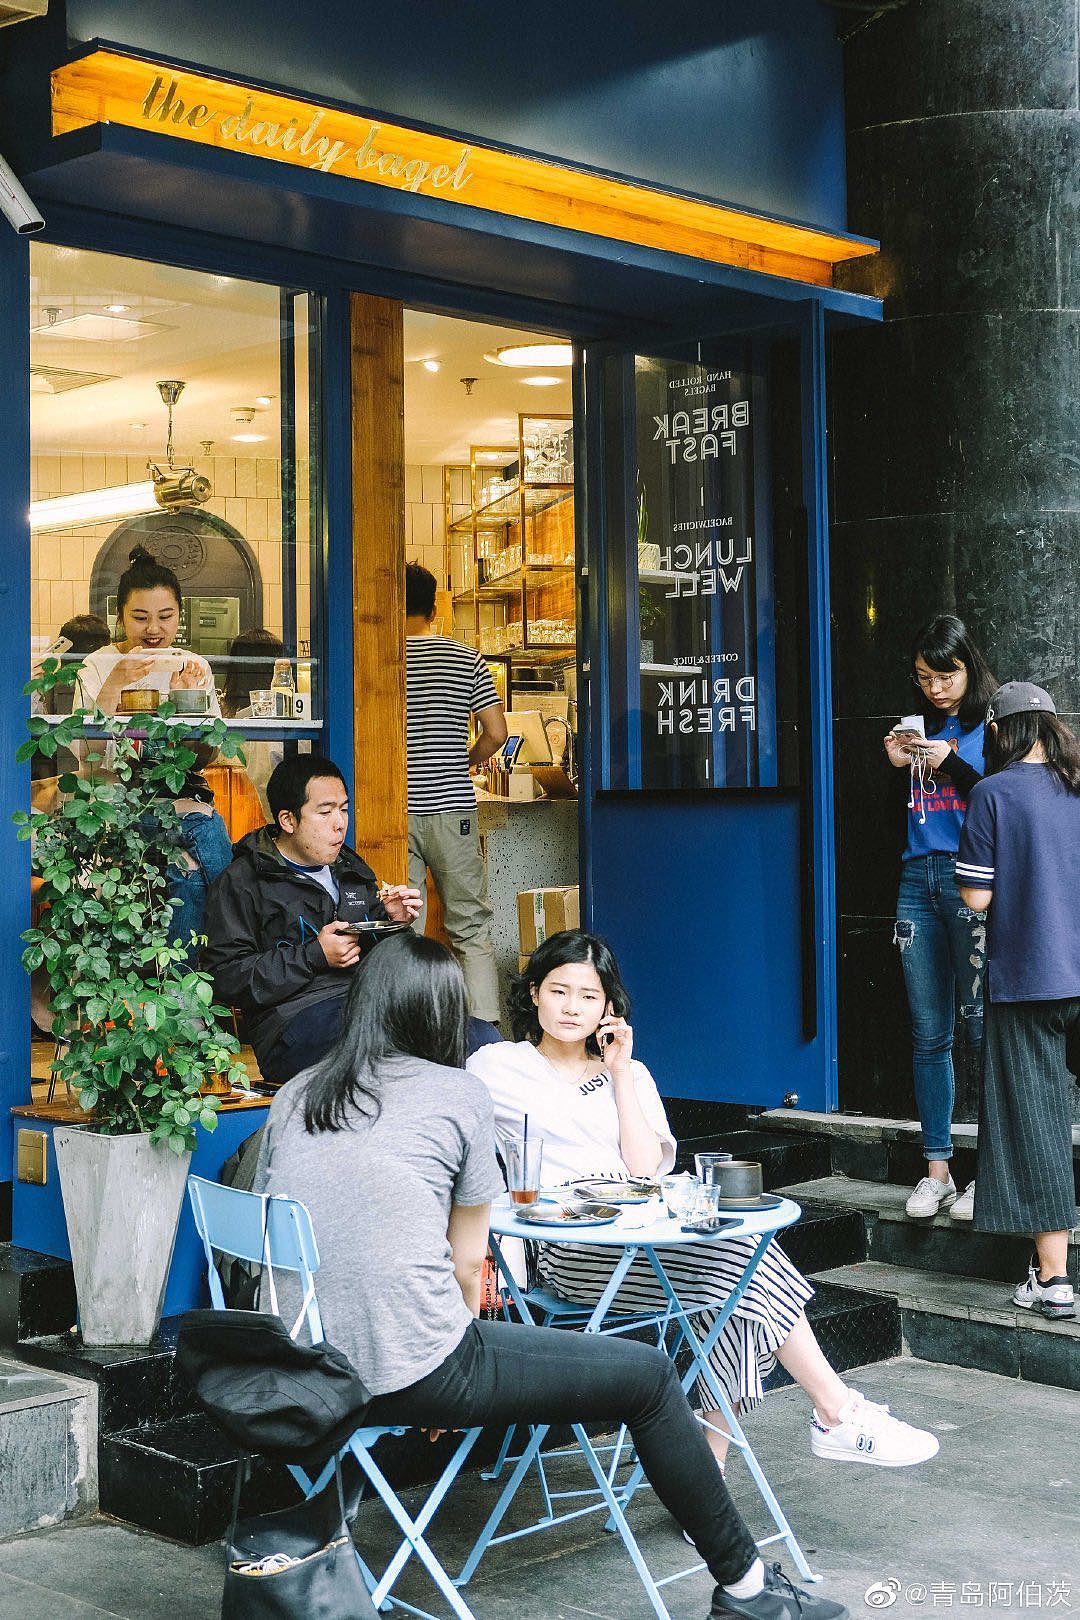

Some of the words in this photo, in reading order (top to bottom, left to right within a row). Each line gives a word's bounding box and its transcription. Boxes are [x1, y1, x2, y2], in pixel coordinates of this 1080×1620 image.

[142, 76, 217, 129] the
[219, 96, 351, 172] daily
[355, 125, 473, 192] bagel
[295, 699, 304, 714] 9
